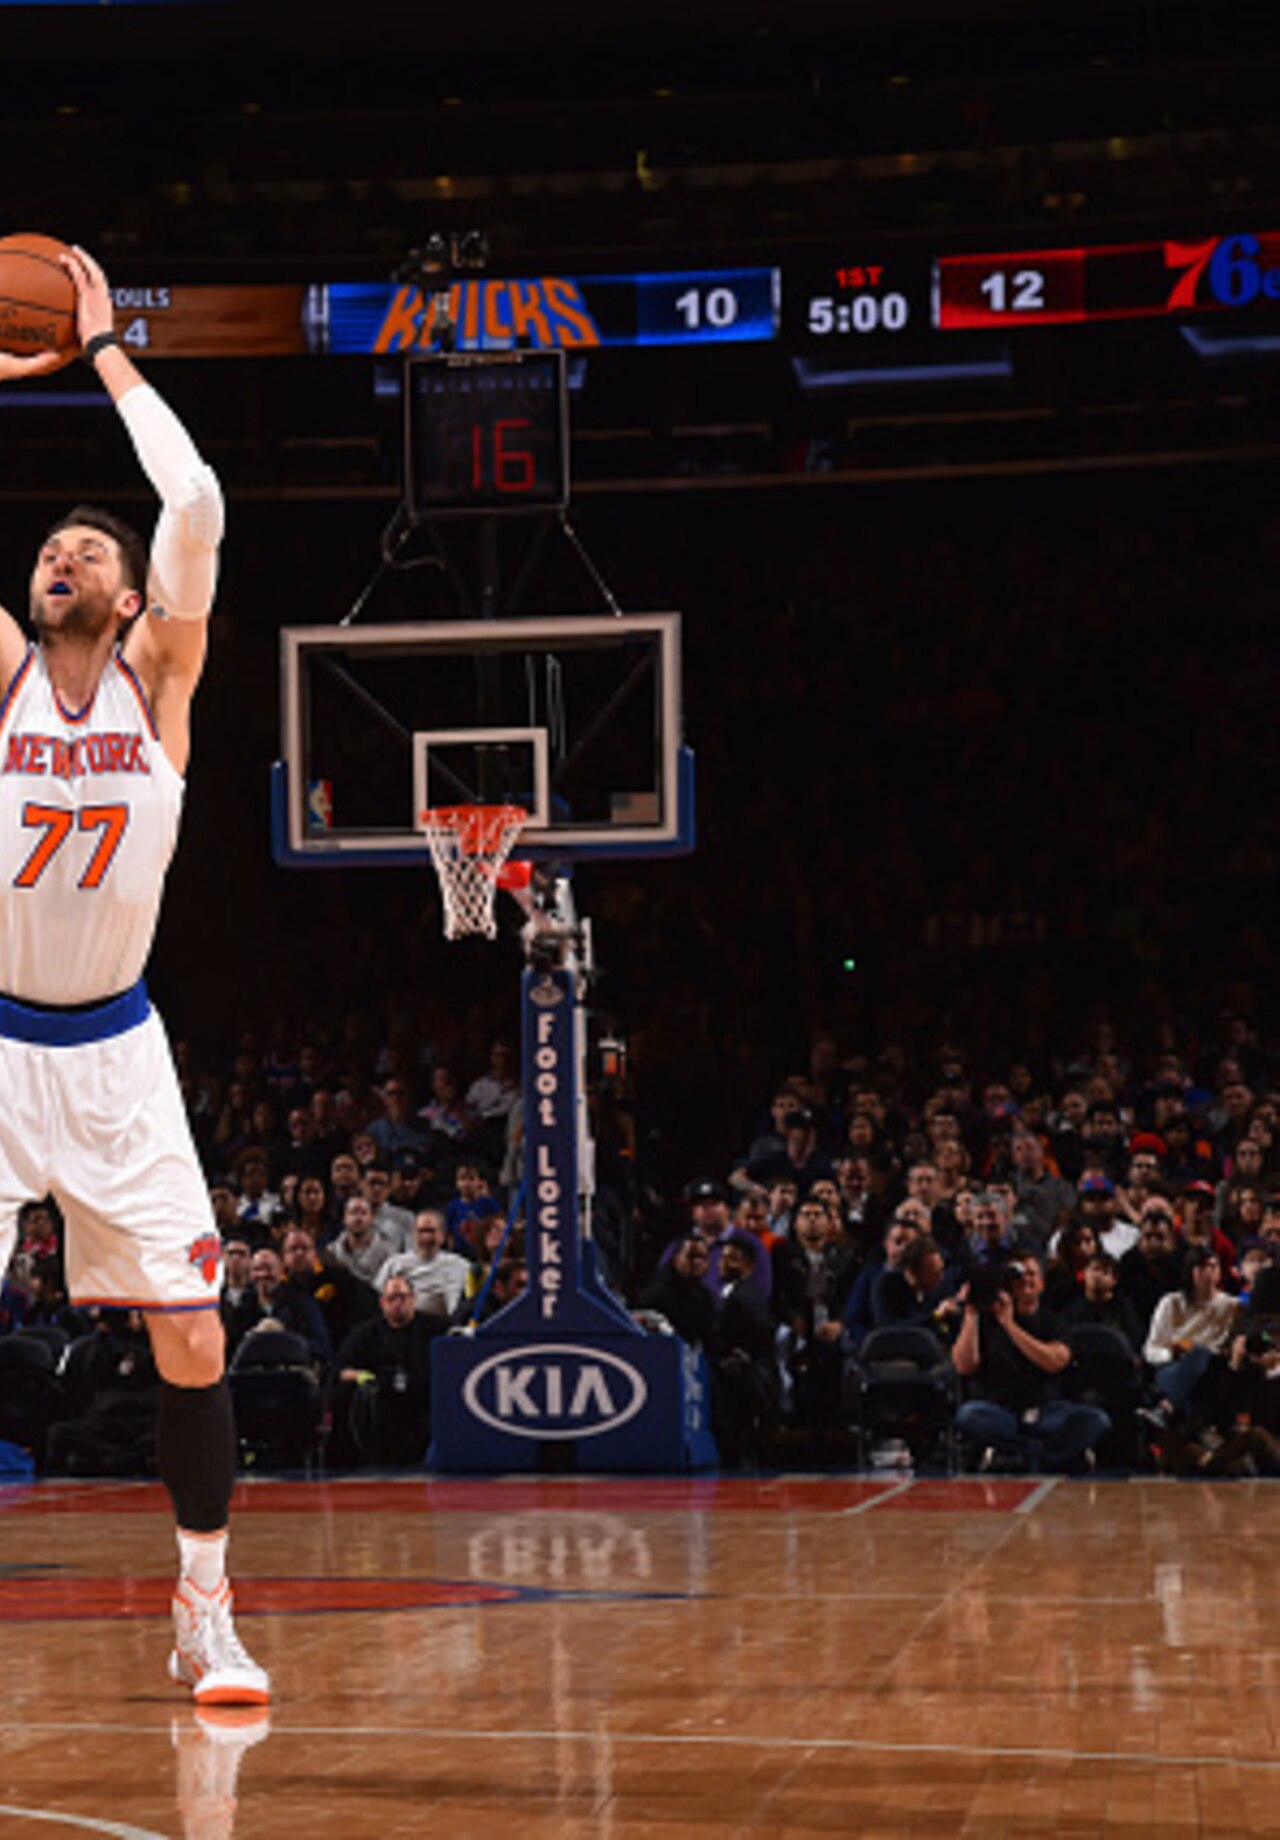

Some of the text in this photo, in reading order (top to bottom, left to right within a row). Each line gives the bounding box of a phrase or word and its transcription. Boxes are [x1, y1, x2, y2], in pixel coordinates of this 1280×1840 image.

[109, 287, 170, 308] OULS
[835, 266, 884, 288] 1ST
[980, 270, 1045, 311] 12
[372, 276, 602, 354] KNICKS
[675, 287, 738, 328] 10
[808, 293, 909, 335] 5:00
[122, 316, 150, 349] 4
[470, 419, 535, 491] 16
[1, 732, 151, 781] NEW YORK
[12, 801, 130, 889] 77
[494, 1366, 616, 1417] KIA
